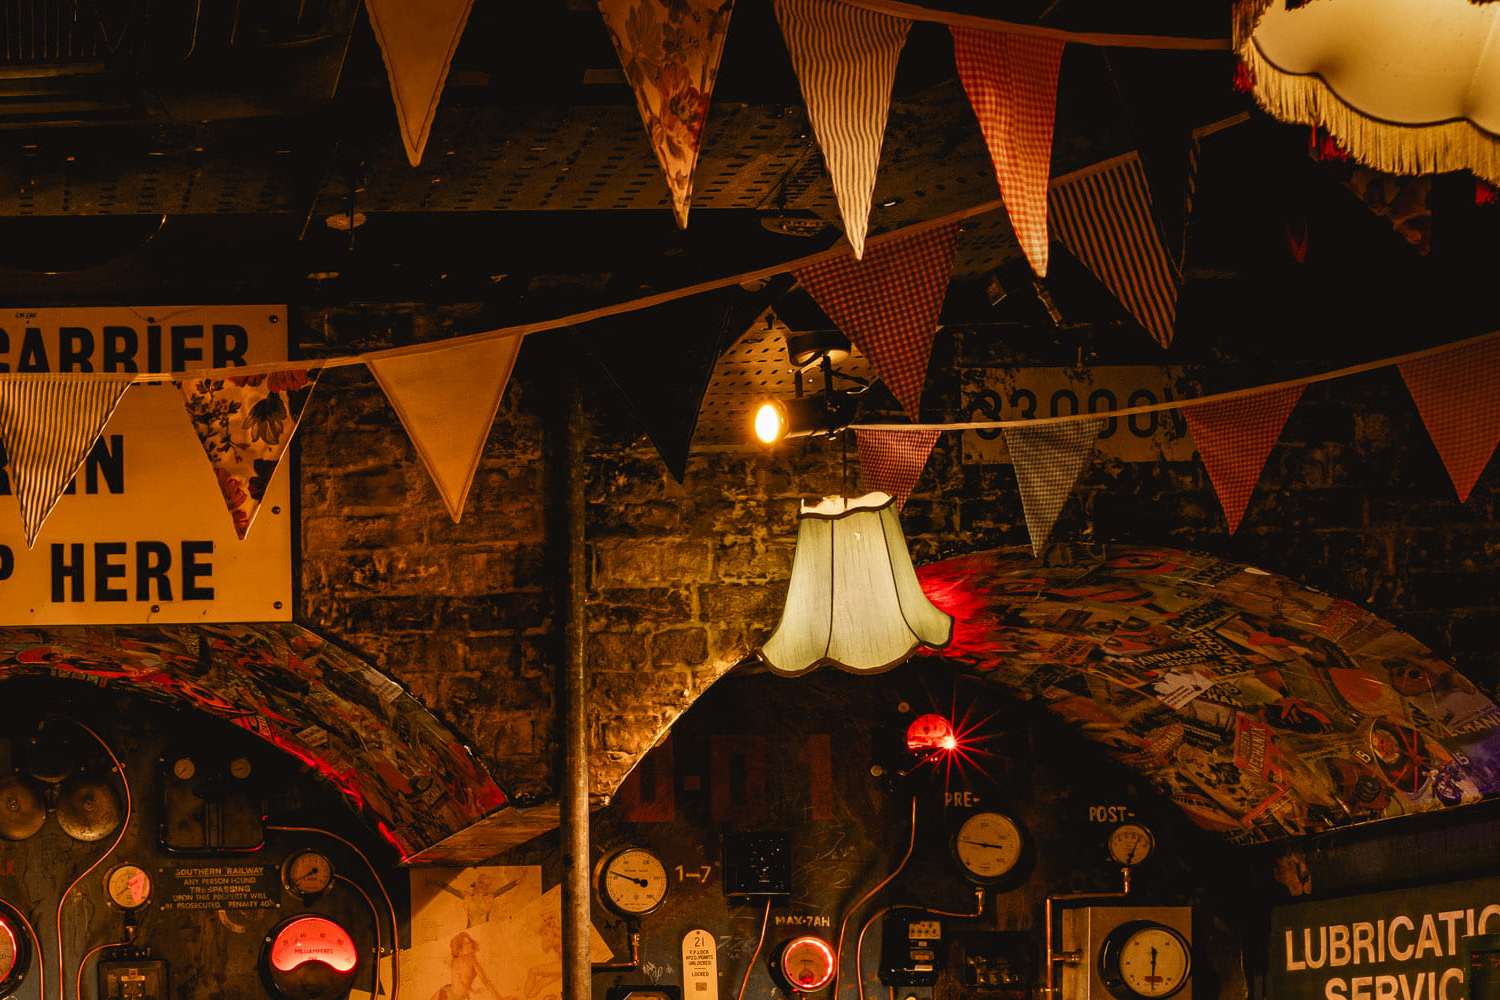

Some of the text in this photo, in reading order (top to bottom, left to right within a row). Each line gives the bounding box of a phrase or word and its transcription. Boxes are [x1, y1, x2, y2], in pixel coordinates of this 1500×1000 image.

[51, 540, 216, 603] HERE
[1088, 805, 1136, 823] POST-
[175, 866, 264, 876] SOUTHERN RAILWAY
[183, 878, 199, 886] ANY
[202, 877, 229, 885] PERSON
[694, 936, 705, 947] 21
